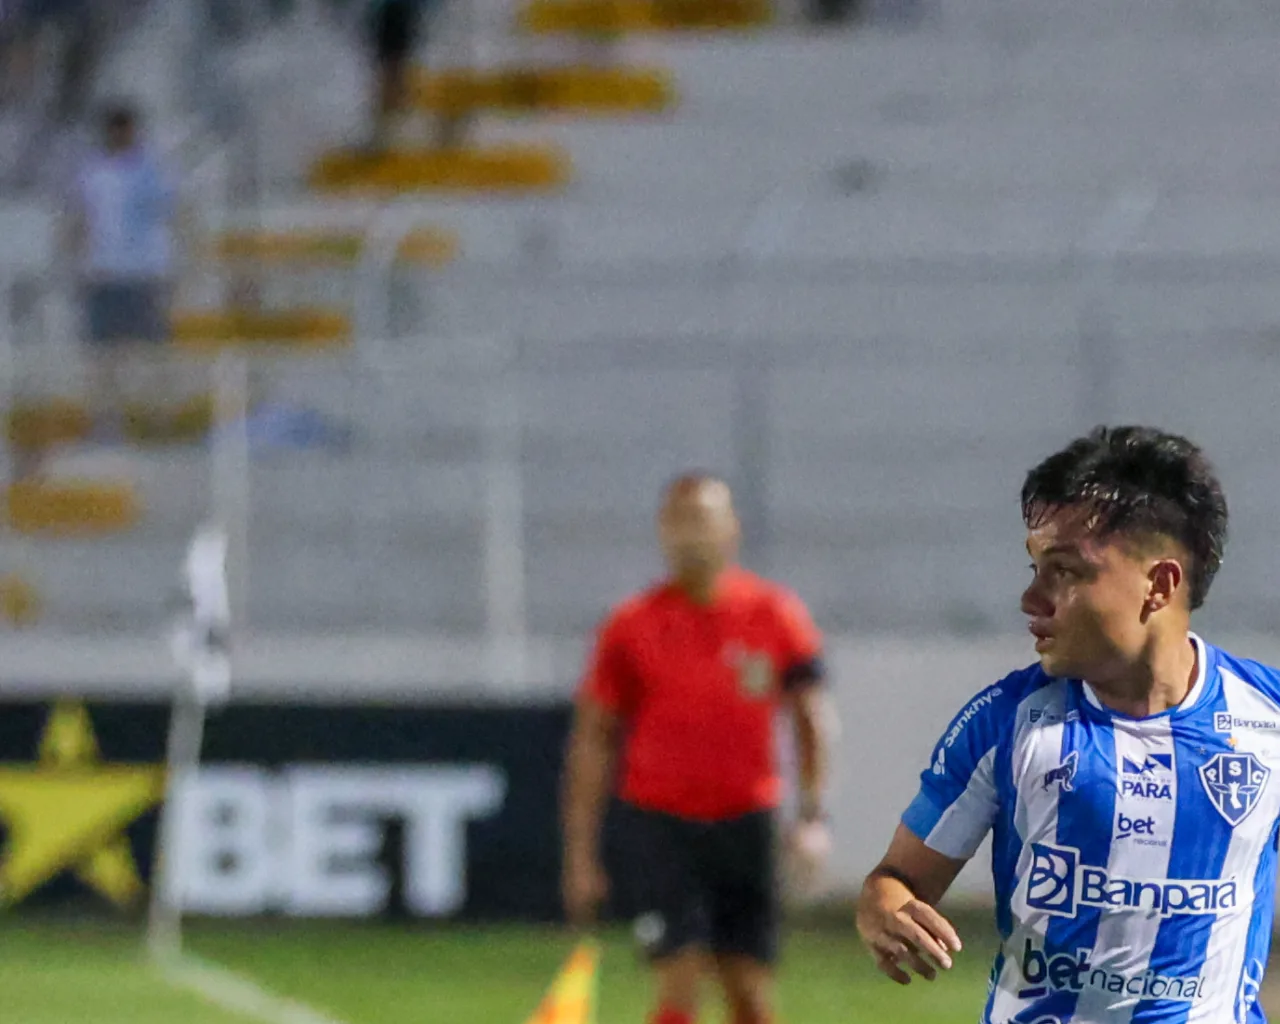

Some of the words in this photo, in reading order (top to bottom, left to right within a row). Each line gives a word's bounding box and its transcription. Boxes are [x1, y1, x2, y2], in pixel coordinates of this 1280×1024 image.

[170, 762, 504, 916] BET
[1117, 812, 1155, 835] bet
[1082, 869, 1237, 914] Banpará
